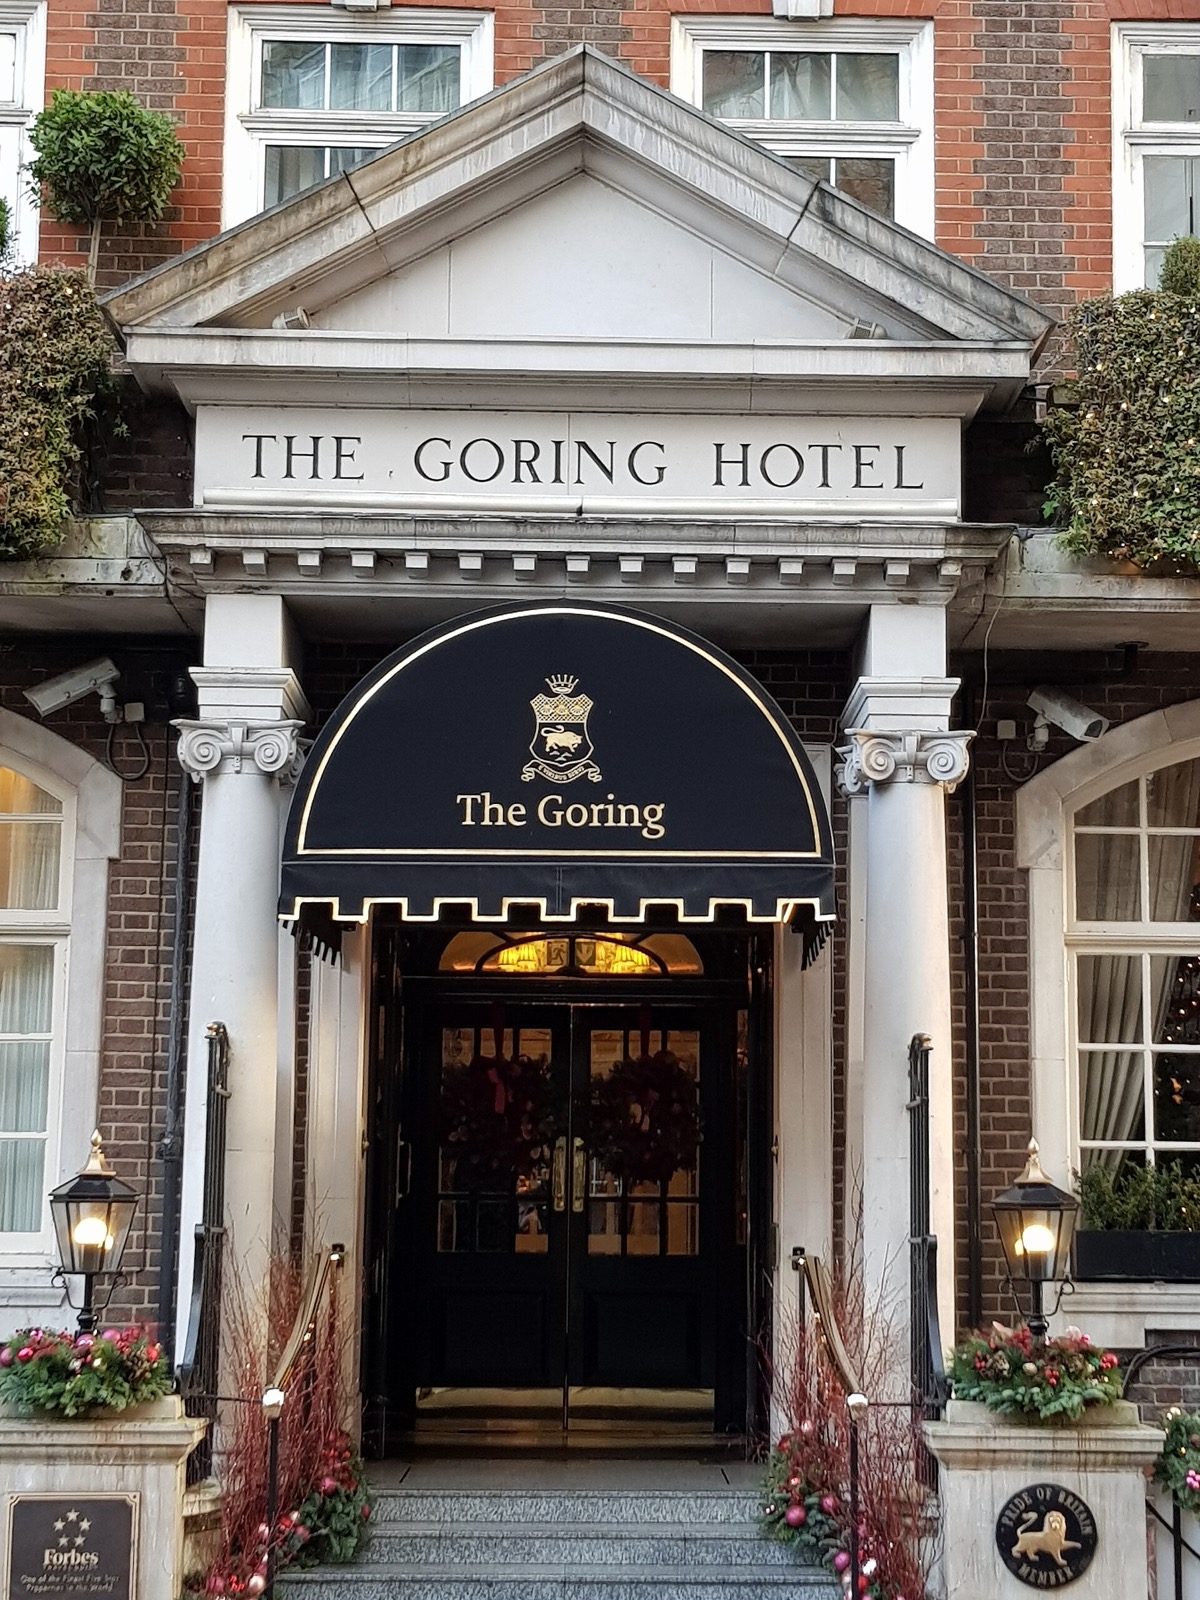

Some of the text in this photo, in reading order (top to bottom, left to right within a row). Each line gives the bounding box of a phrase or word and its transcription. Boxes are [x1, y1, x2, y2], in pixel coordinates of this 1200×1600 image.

[242, 434, 924, 490] THE GORING HOTEL
[456, 791, 666, 839] The Goring
[1001, 1487, 1093, 1535] PRIDE OF BRITAIN
[43, 1548, 99, 1566] Forbes
[1018, 1562, 1074, 1586] MEMBER
